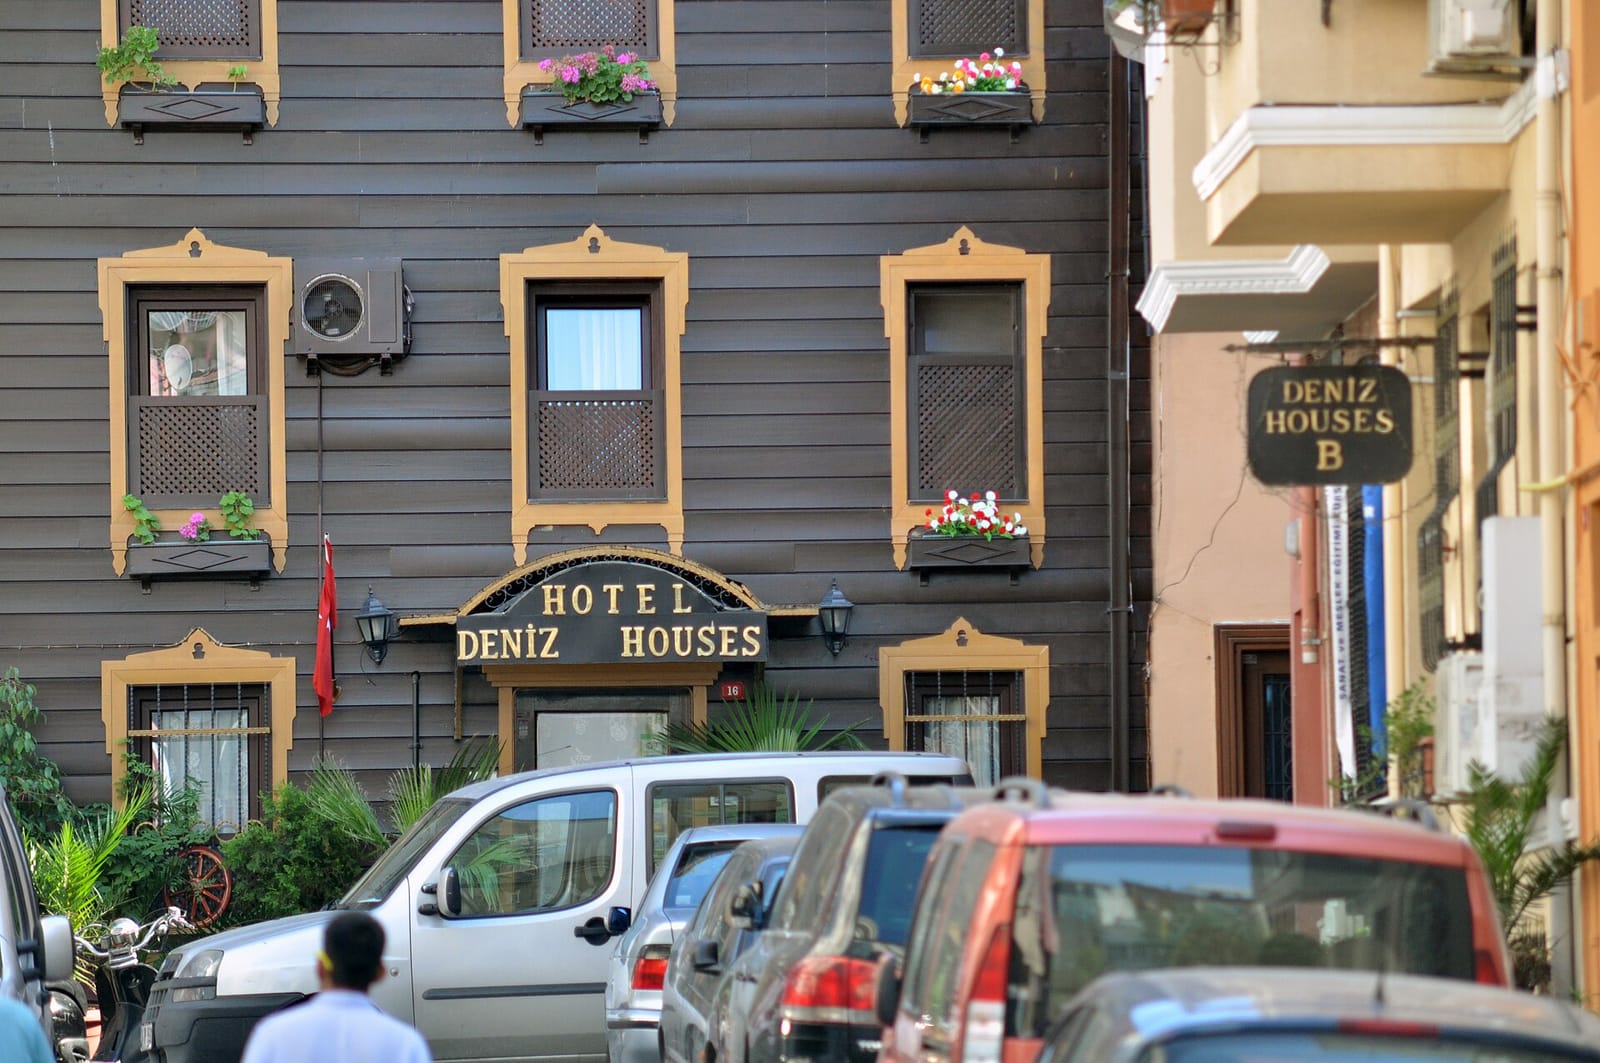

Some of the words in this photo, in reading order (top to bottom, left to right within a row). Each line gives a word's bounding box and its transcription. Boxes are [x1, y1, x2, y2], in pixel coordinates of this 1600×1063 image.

[1265, 408, 1395, 434] HOUSES
[1316, 439, 1343, 471] B
[542, 583, 692, 615] HOTEL
[1334, 582, 1344, 632] MESLEK
[620, 624, 761, 657] HOUSES
[727, 685, 739, 696] 16
[1337, 658, 1347, 700] SANAT
